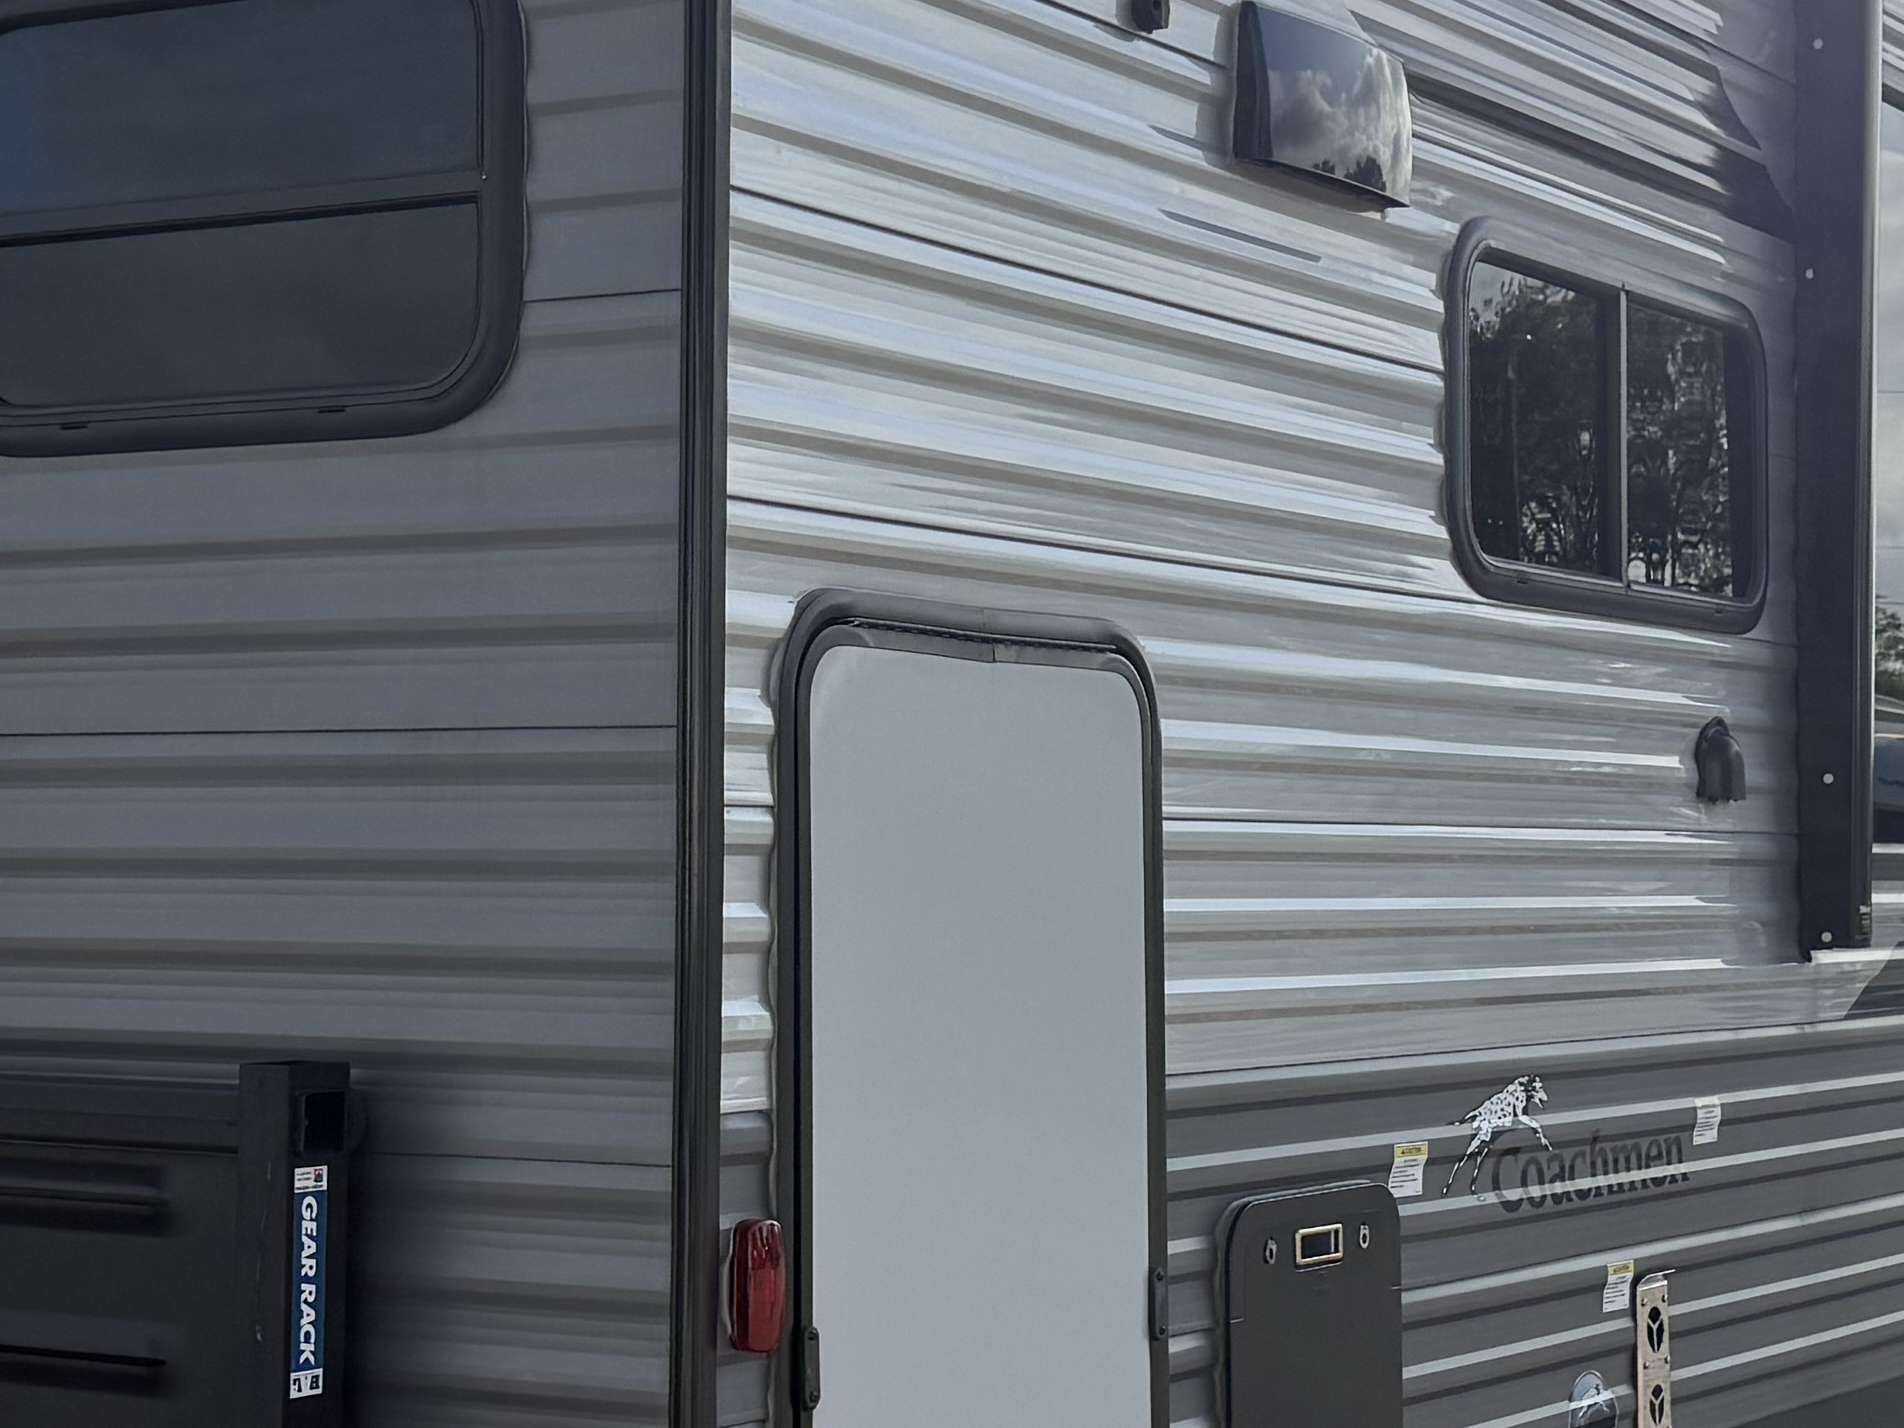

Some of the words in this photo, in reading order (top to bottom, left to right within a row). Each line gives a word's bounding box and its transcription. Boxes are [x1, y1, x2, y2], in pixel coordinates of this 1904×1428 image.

[1491, 1128, 1691, 1214] Coachmen
[300, 1195, 318, 1277] GEAR
[299, 1282, 317, 1366] RACK
